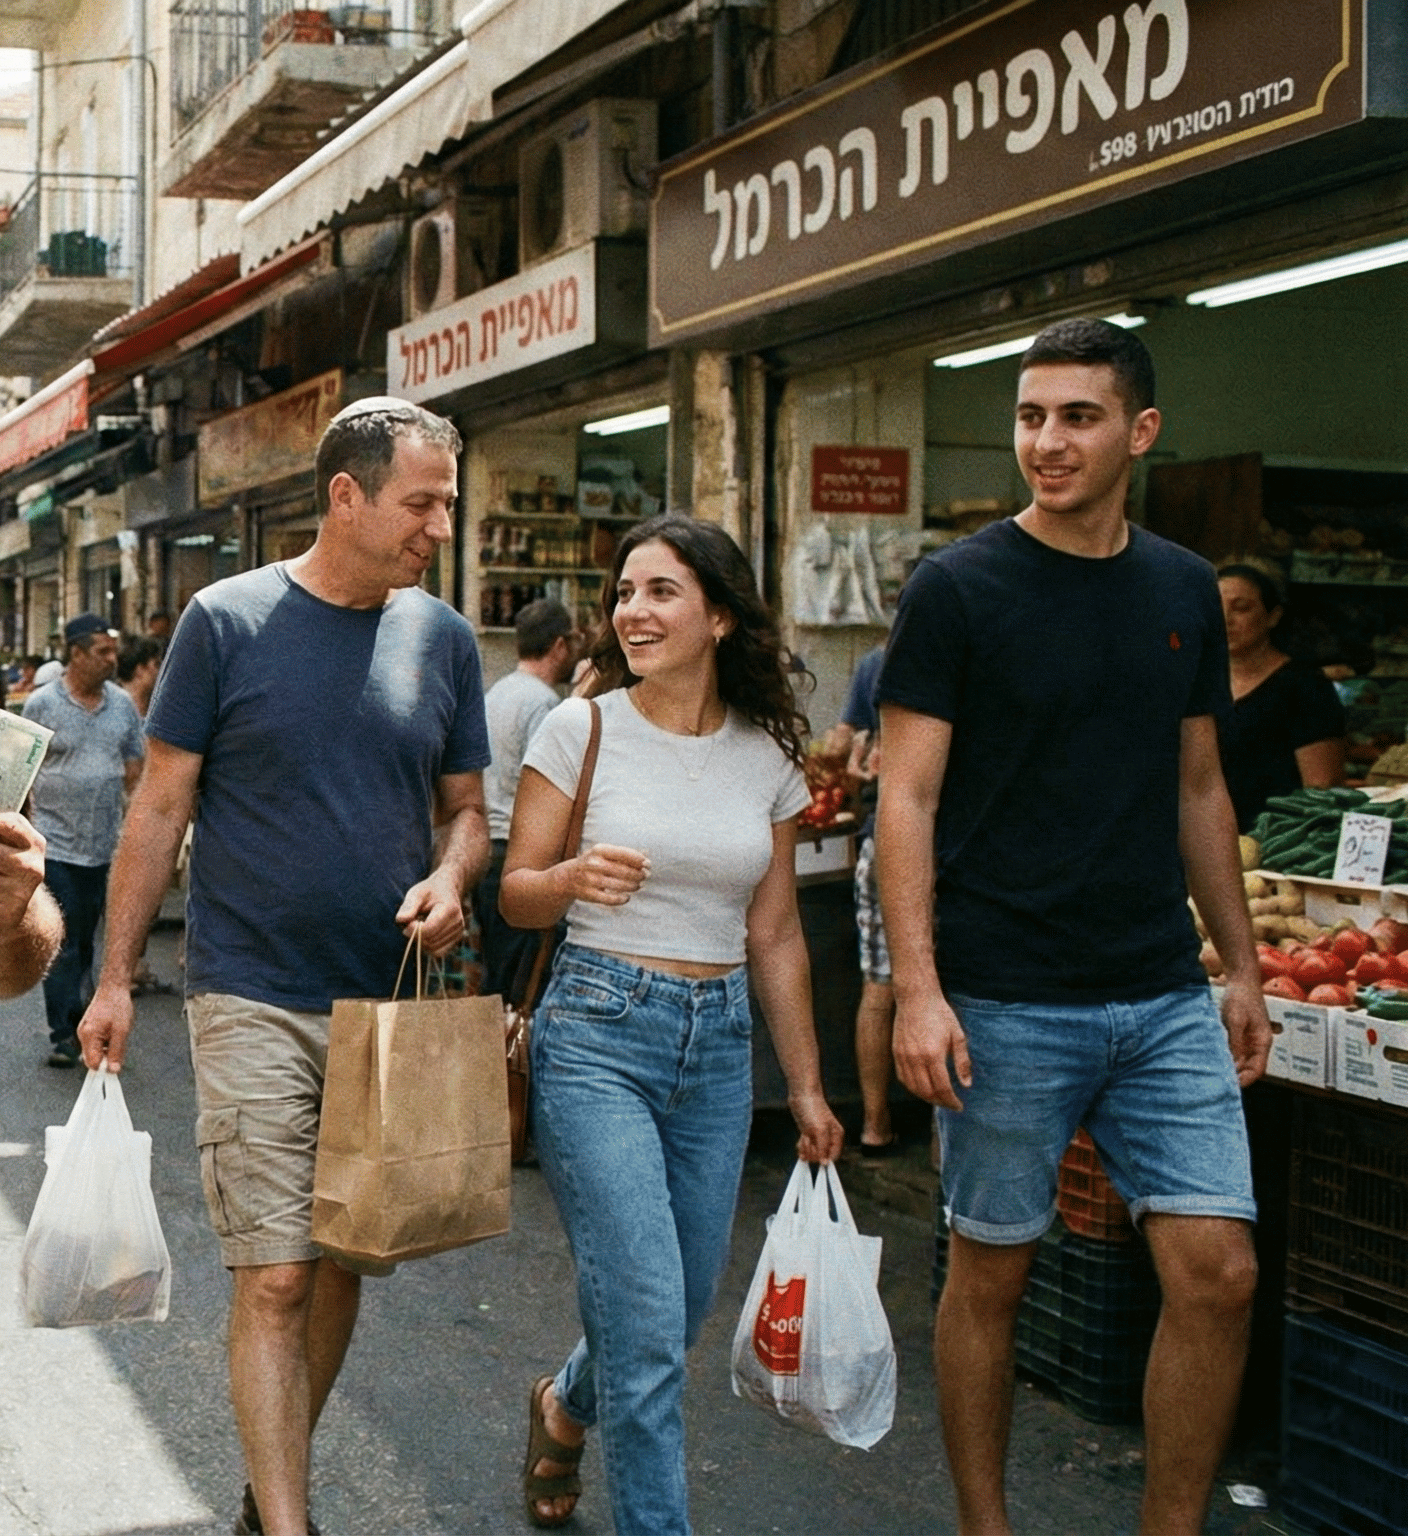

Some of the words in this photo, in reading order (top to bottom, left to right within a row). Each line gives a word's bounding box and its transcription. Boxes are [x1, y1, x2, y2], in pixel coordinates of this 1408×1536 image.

[899, 0, 1189, 198] מאפיית
[704, 127, 878, 271] הכרמל
[400, 320, 471, 389] הכרמל
[479, 275, 579, 363] מאפיית
